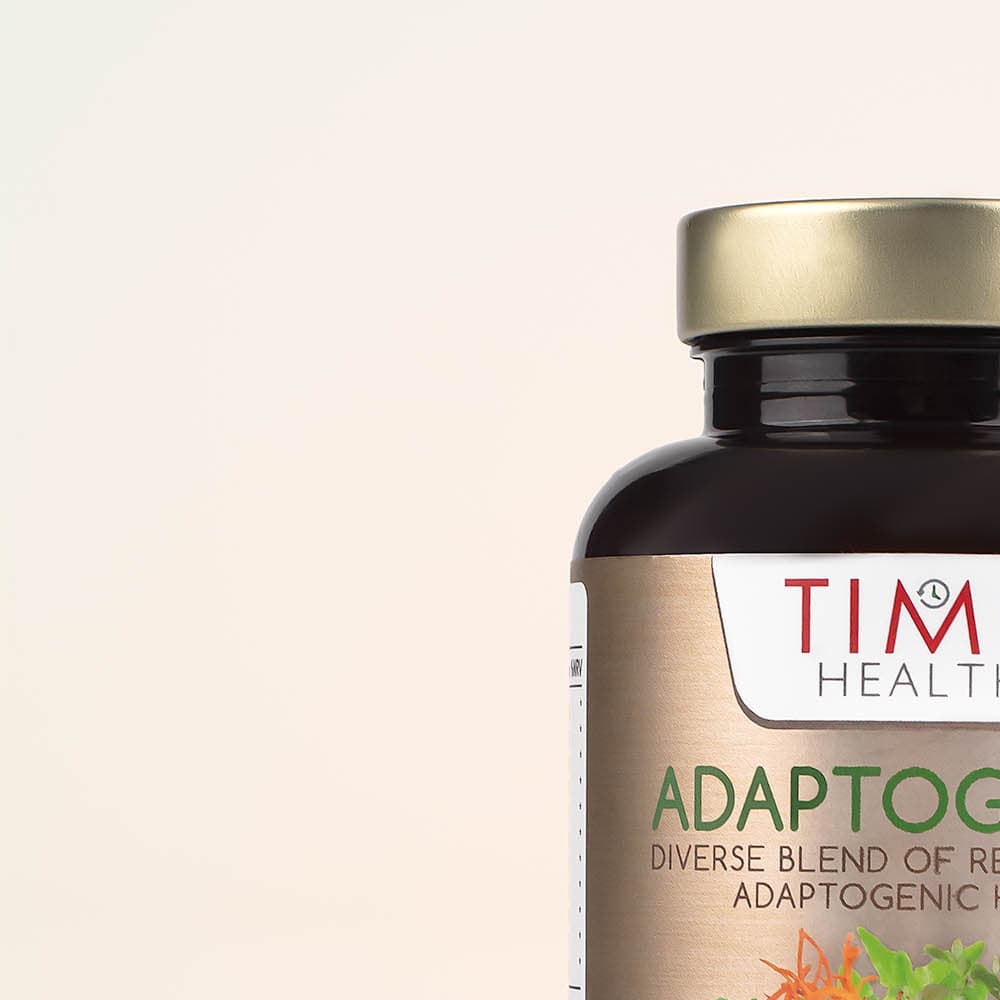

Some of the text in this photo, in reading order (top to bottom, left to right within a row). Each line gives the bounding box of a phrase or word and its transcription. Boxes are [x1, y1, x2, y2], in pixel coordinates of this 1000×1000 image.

[652, 844, 764, 872] DIVERSE
[779, 846, 887, 873] BLEND
[904, 846, 951, 873] OF
[733, 883, 979, 911] ADAPTOGENIC
